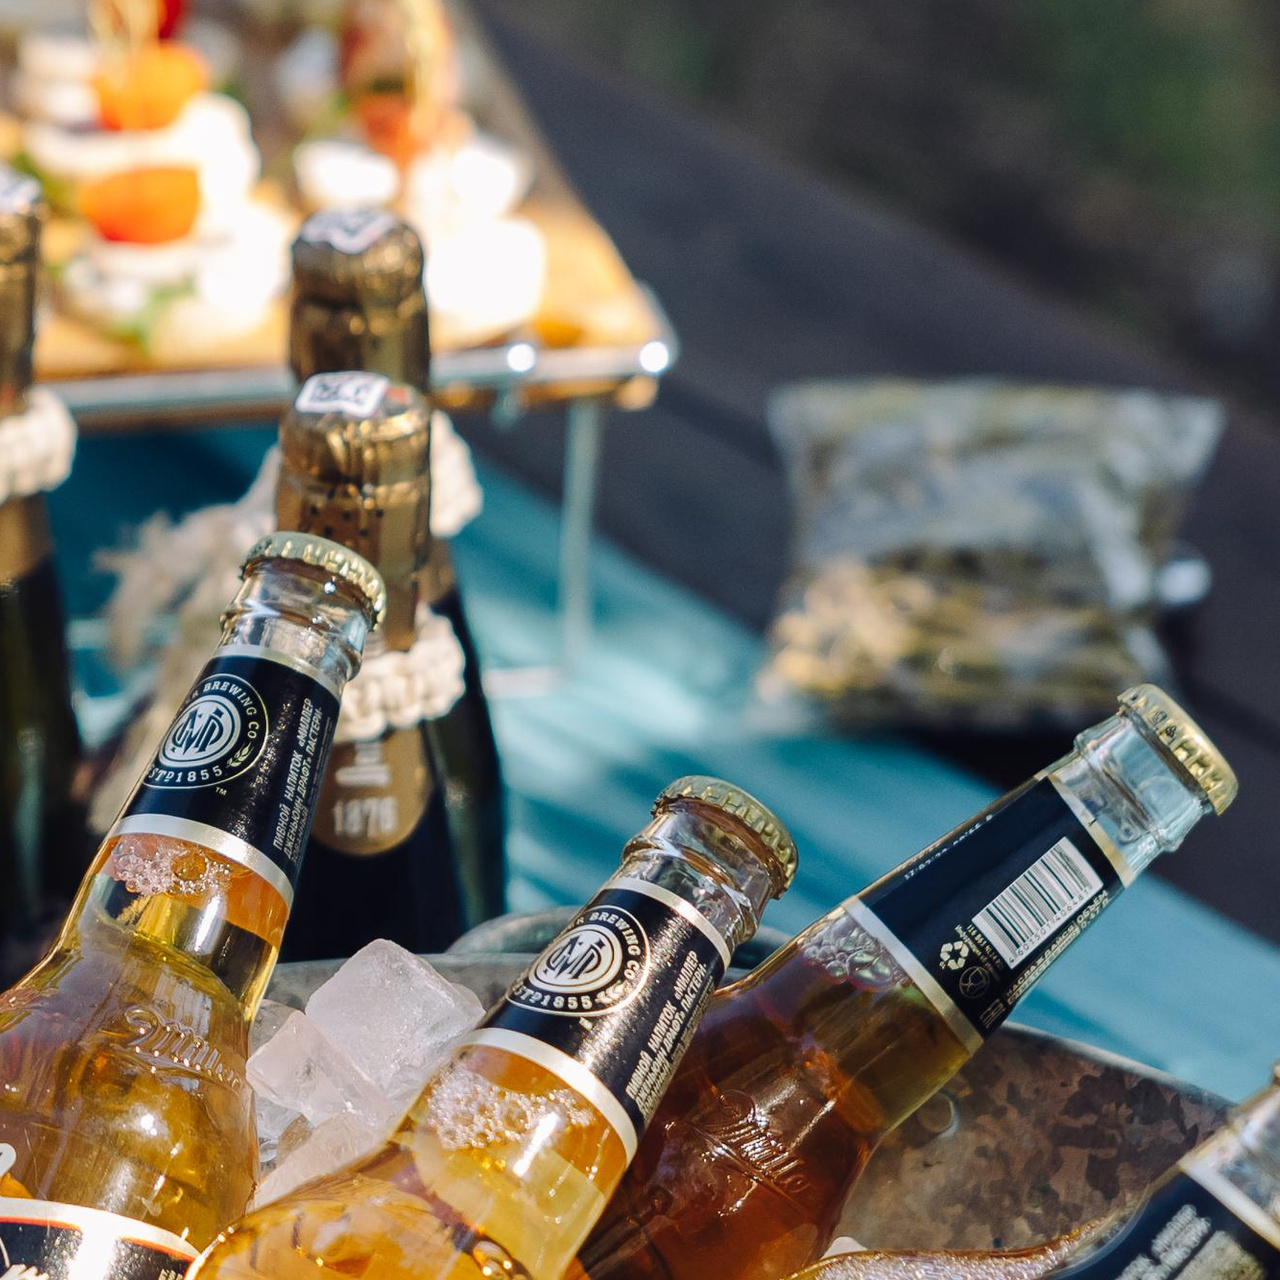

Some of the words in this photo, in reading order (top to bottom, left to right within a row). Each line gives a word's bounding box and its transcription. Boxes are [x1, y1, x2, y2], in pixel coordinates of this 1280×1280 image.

[203, 681, 257, 716] BREWING
[247, 721, 260, 739] CO
[176, 765, 223, 782] 1855
[273, 803, 291, 851] ПИВНОЙ
[284, 751, 304, 802] НАПИТОК
[298, 697, 315, 748] «МИЛЛЕР
[283, 796, 304, 858] ДЖЕНЬЮИН
[301, 757, 313, 801] ДРАФТ»
[589, 911, 641, 956] BREWING
[624, 960, 640, 980] CO
[541, 994, 593, 1010] 1855
[625, 1050, 653, 1100] ПИВНОЙ
[648, 1000, 677, 1052] НАПИТОК
[674, 950, 699, 1001] «МИЛЛЕР
